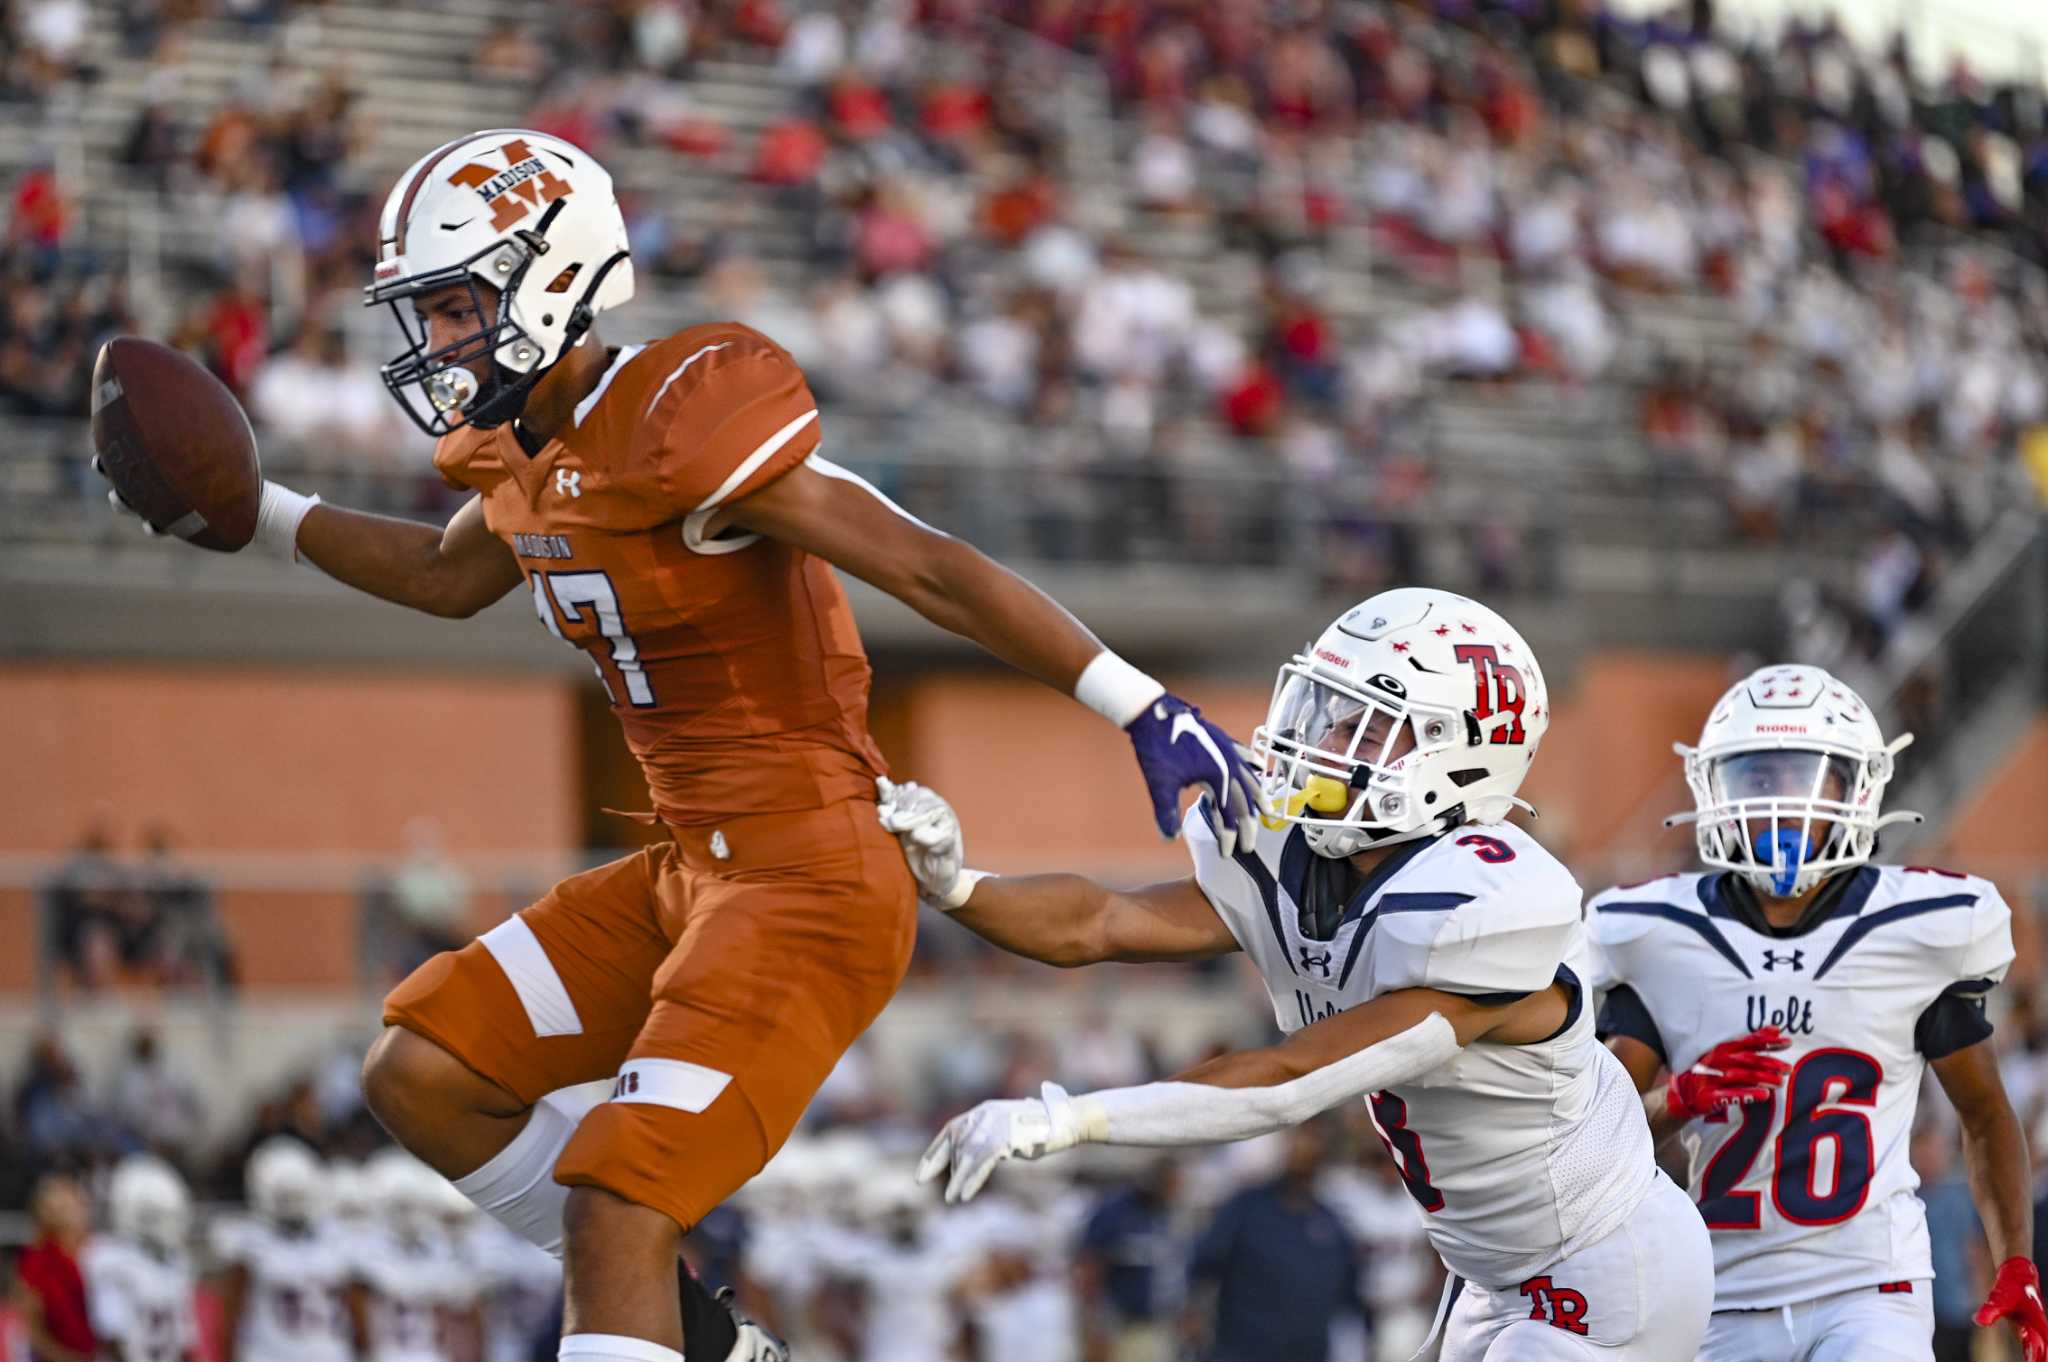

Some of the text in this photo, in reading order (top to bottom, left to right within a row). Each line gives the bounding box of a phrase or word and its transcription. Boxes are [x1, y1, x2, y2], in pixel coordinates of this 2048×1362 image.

[476, 158, 547, 203] MADISON
[1453, 643, 1527, 745] TR
[1455, 834, 1517, 864] 3
[1699, 1046, 1884, 1230] 26
[1520, 1275, 1589, 1336] TR
